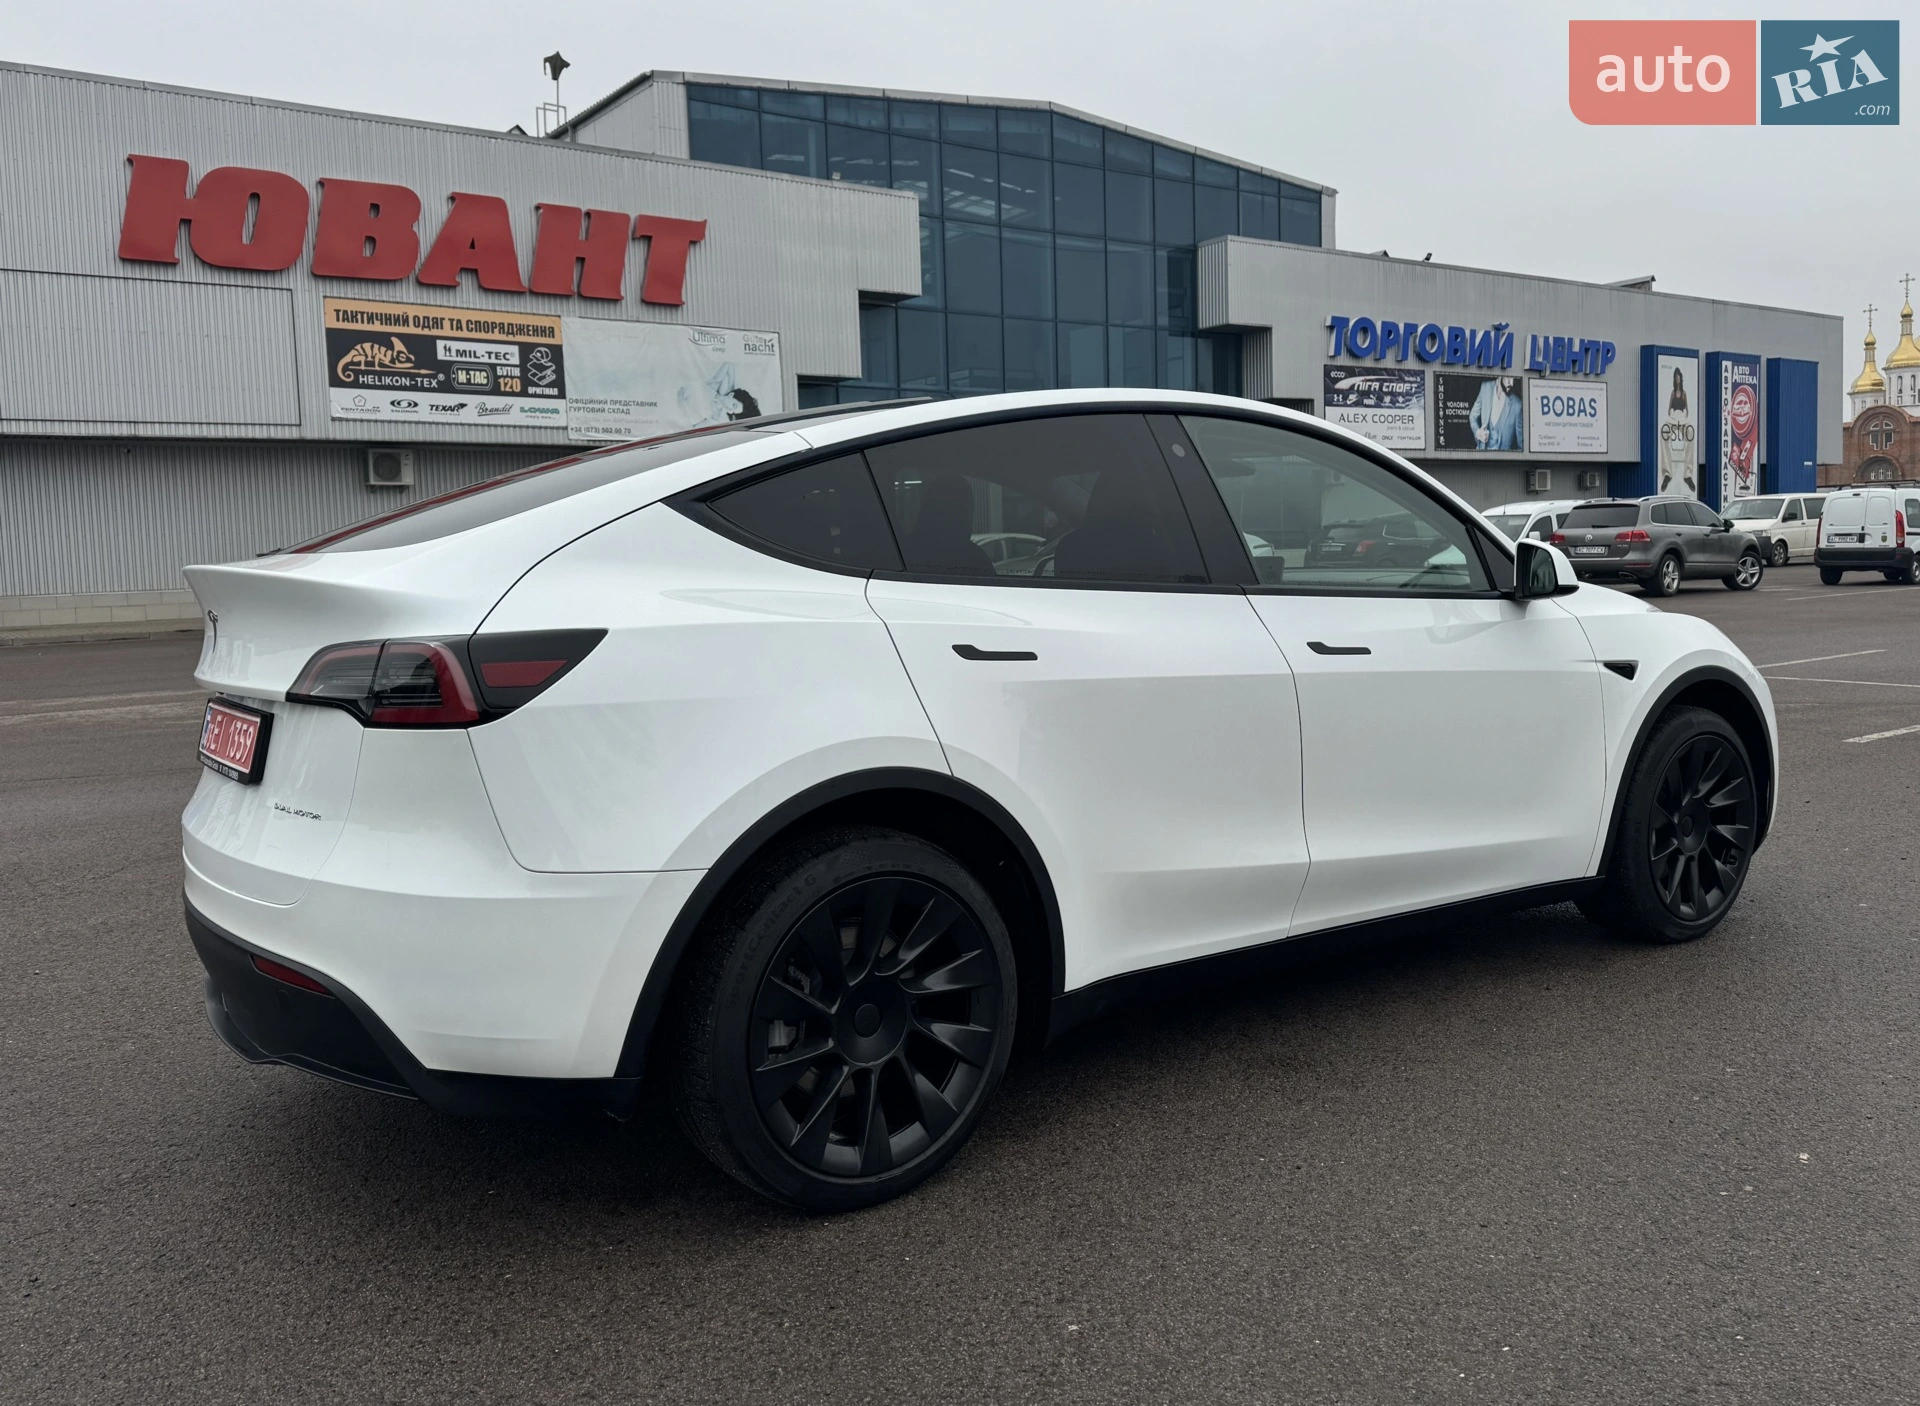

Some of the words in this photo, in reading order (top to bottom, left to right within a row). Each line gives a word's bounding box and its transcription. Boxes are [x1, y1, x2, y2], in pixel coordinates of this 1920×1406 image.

[118, 153, 707, 306] ЮВАНТ
[333, 308, 410, 328] ТАКТИЧНИЙ
[412, 315, 446, 331] ОДЯГ
[447, 318, 463, 332] ТА
[465, 320, 556, 339] СПОРЯДЖЕННЯ
[692, 331, 726, 344] Ultima
[744, 338, 776, 353] nacht
[1326, 315, 1514, 368] ТОРГОВИЙ
[1524, 334, 1616, 377] ЦЕНТР
[455, 349, 511, 361] MIL-TEC
[496, 366, 520, 377] БУТІК
[359, 374, 438, 388] HELIKON-TEX
[498, 378, 521, 392] 120
[527, 386, 559, 395] ОРИГІНАЛ
[428, 403, 462, 412] TEXAR
[475, 402, 514, 414] Brandit
[568, 397, 608, 405] ОФІЦІЙНИЙ
[609, 399, 658, 408] ПРЕДСТАВНИК
[1540, 395, 1598, 418] BOBAS
[568, 406, 606, 414] ГУРТОВИЙ
[607, 407, 631, 415] СКЛАД
[1338, 413, 1368, 423] ALEX
[1371, 414, 1415, 425] COOPER
[1660, 420, 1695, 442] estro
[226, 719, 255, 763] 1359
